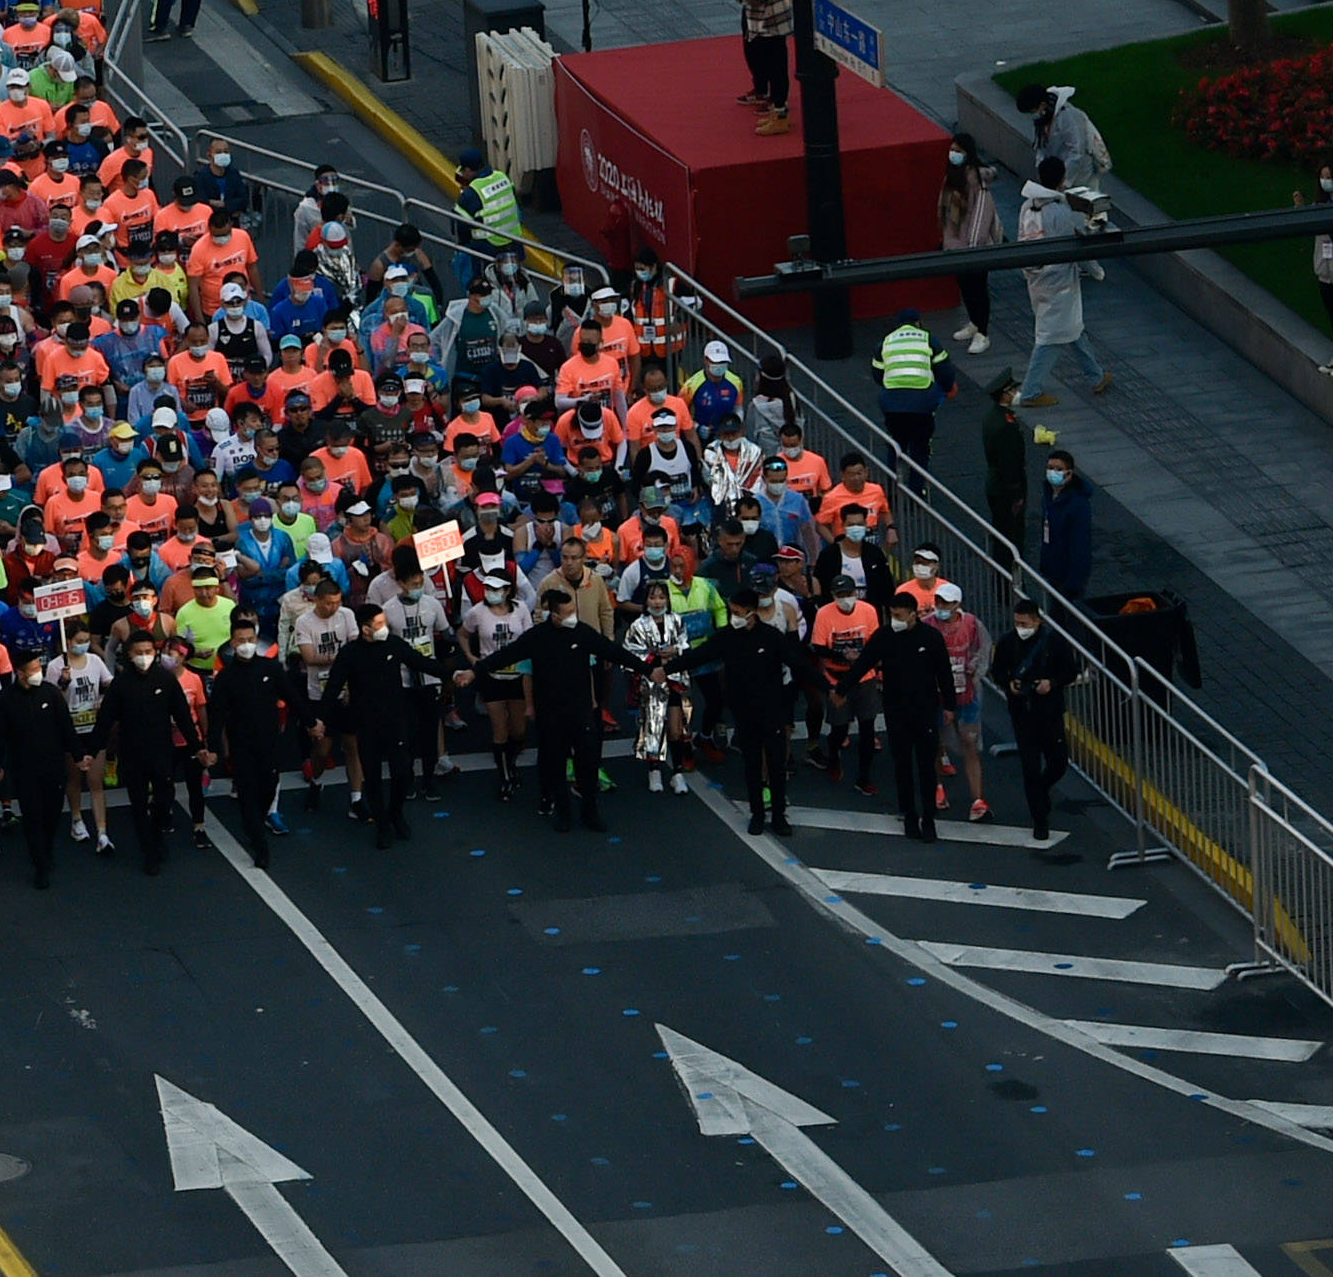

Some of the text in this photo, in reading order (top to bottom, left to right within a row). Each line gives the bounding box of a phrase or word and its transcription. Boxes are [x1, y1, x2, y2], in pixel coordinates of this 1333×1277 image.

[827, 11, 866, 54] 中山东一路
